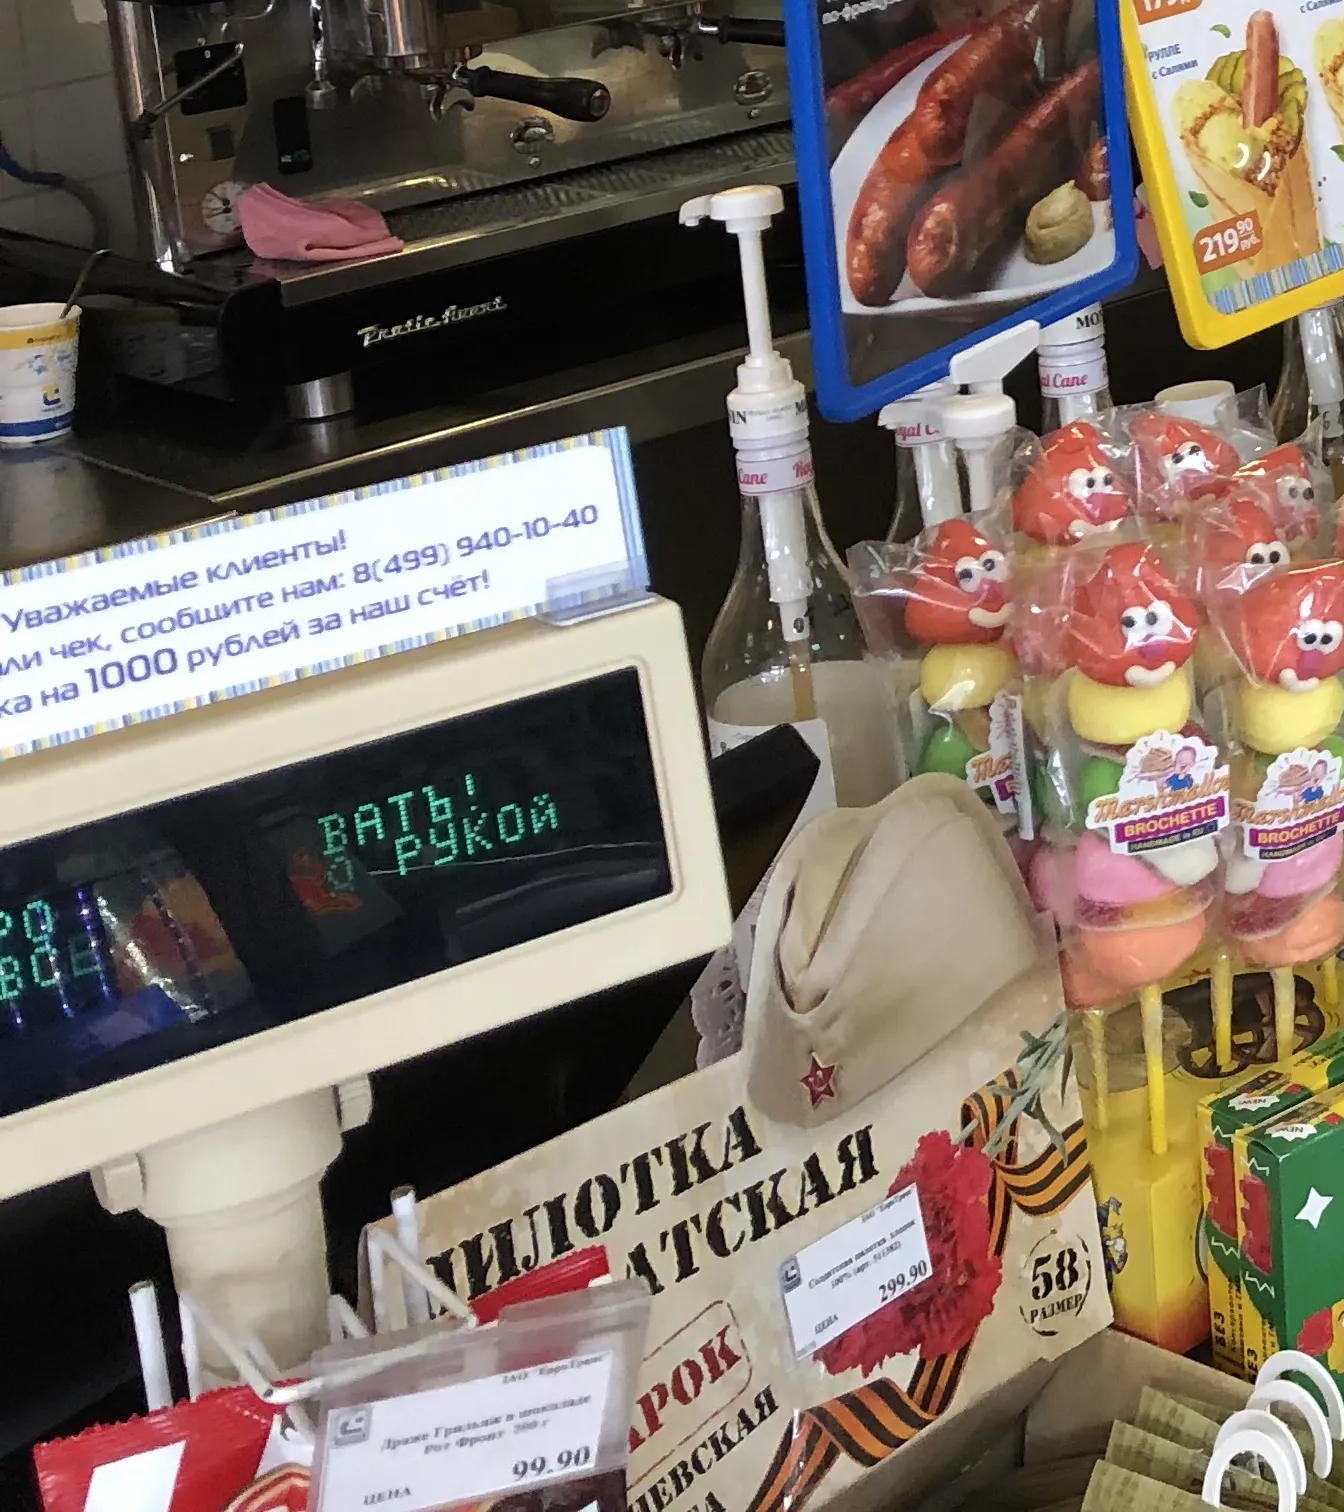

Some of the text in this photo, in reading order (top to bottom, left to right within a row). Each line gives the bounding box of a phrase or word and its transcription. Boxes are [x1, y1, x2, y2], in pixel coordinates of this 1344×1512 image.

[1148, 43, 1182, 63] РУЛЛЕ
[2, 529, 349, 635] Уважаемые клиенты!
[50, 505, 599, 661] чек, сообщите нам: 8(499) 940-10-40
[40, 568, 491, 708] на 1000 рублей за наш счёт!
[395, 792, 561, 876] РУКОЙ
[1124, 803, 1218, 838] BROCHETTE
[1257, 811, 1341, 845] BROCHETTE
[426, 1104, 765, 1319] ПИЛОТКА
[878, 1259, 928, 1304] 299.90
[1031, 1247, 1079, 1301] 58
[1029, 1292, 1084, 1324] РАЗМЕР
[380, 1431, 430, 1452] Драже
[511, 1444, 591, 1482] 99.90
[363, 1486, 412, 1507] ЦЕНА
